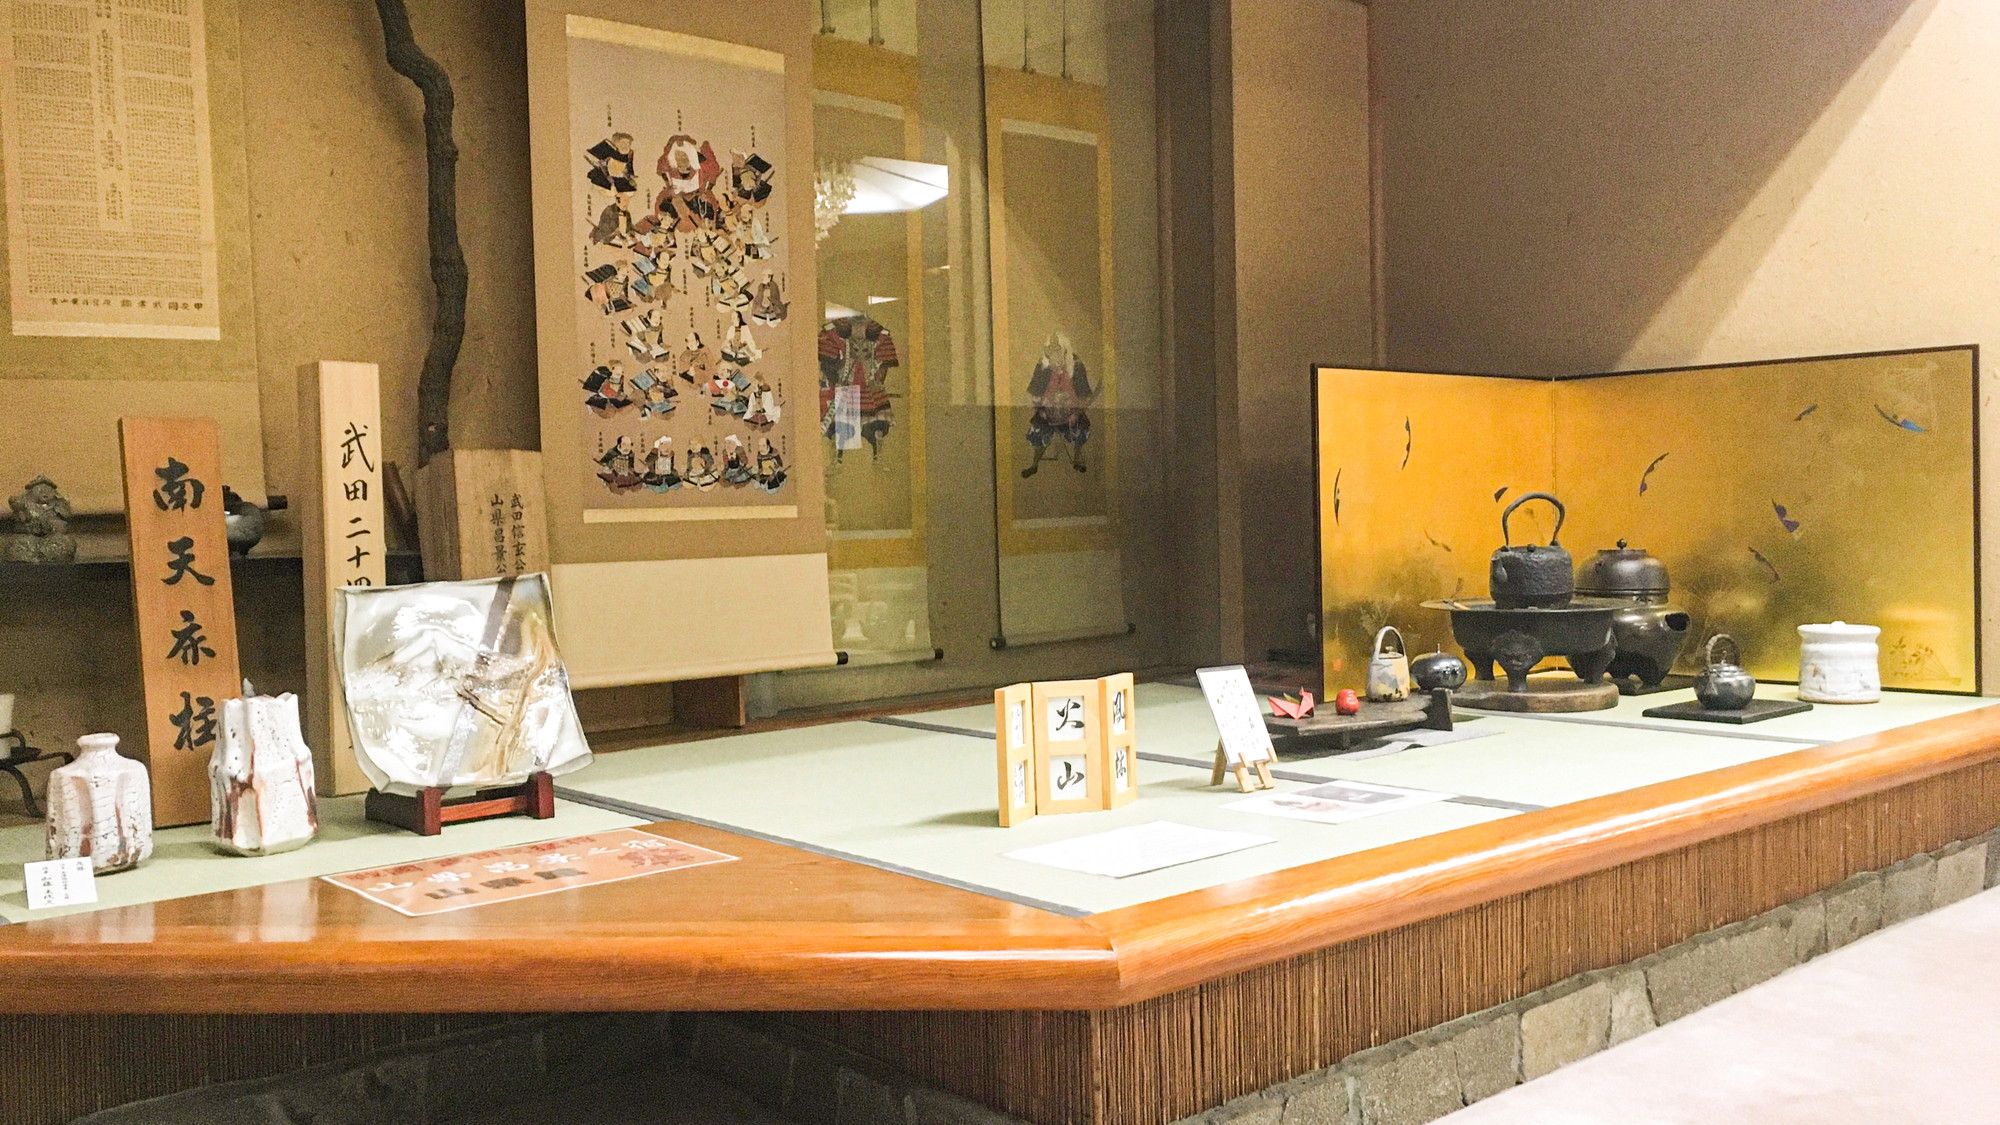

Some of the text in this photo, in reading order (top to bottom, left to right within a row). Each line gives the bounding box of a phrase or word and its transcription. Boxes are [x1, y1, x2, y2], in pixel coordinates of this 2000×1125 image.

[490, 494, 508, 574] 山県昌景公
[510, 493, 527, 570] 武田信玄公
